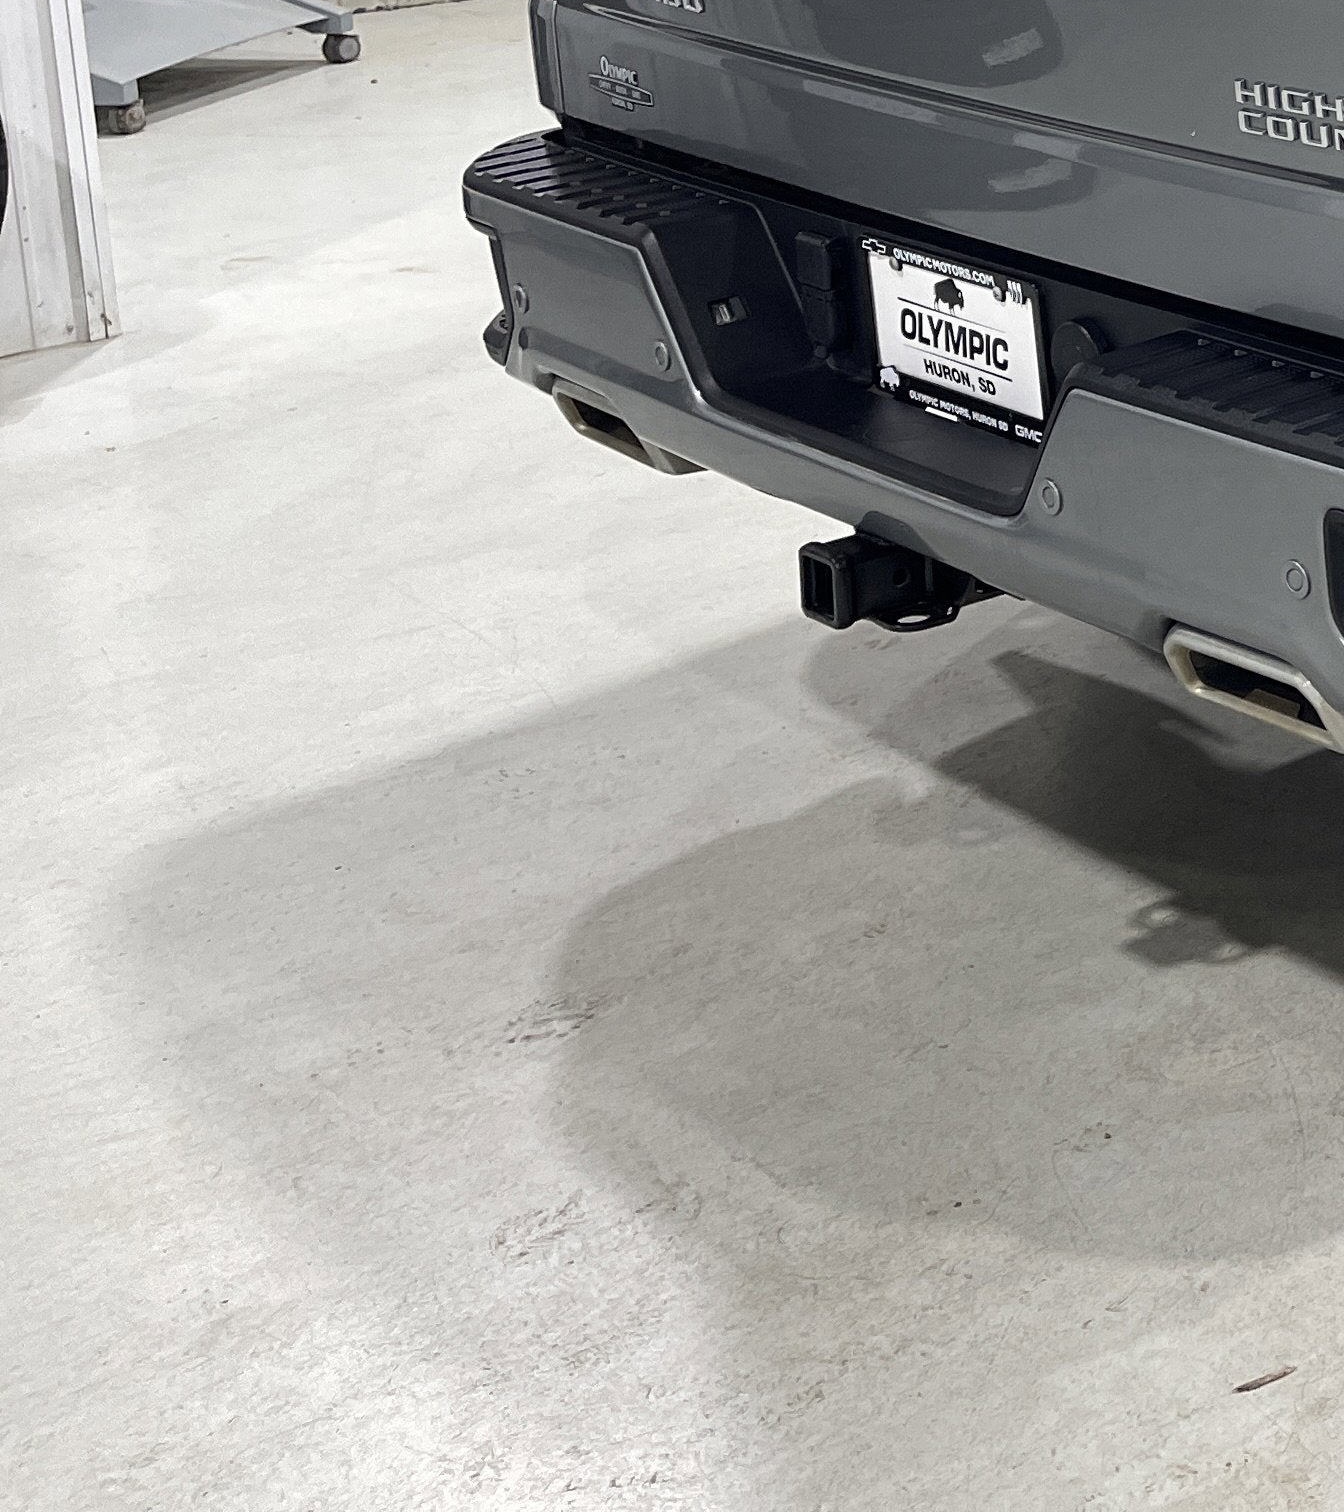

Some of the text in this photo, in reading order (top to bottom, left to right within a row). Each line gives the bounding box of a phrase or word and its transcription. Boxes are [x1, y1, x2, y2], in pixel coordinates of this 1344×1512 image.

[900, 307, 1009, 372] OLYMPIC
[923, 358, 996, 396] HURON, SD
[1015, 424, 1043, 443] GMC
